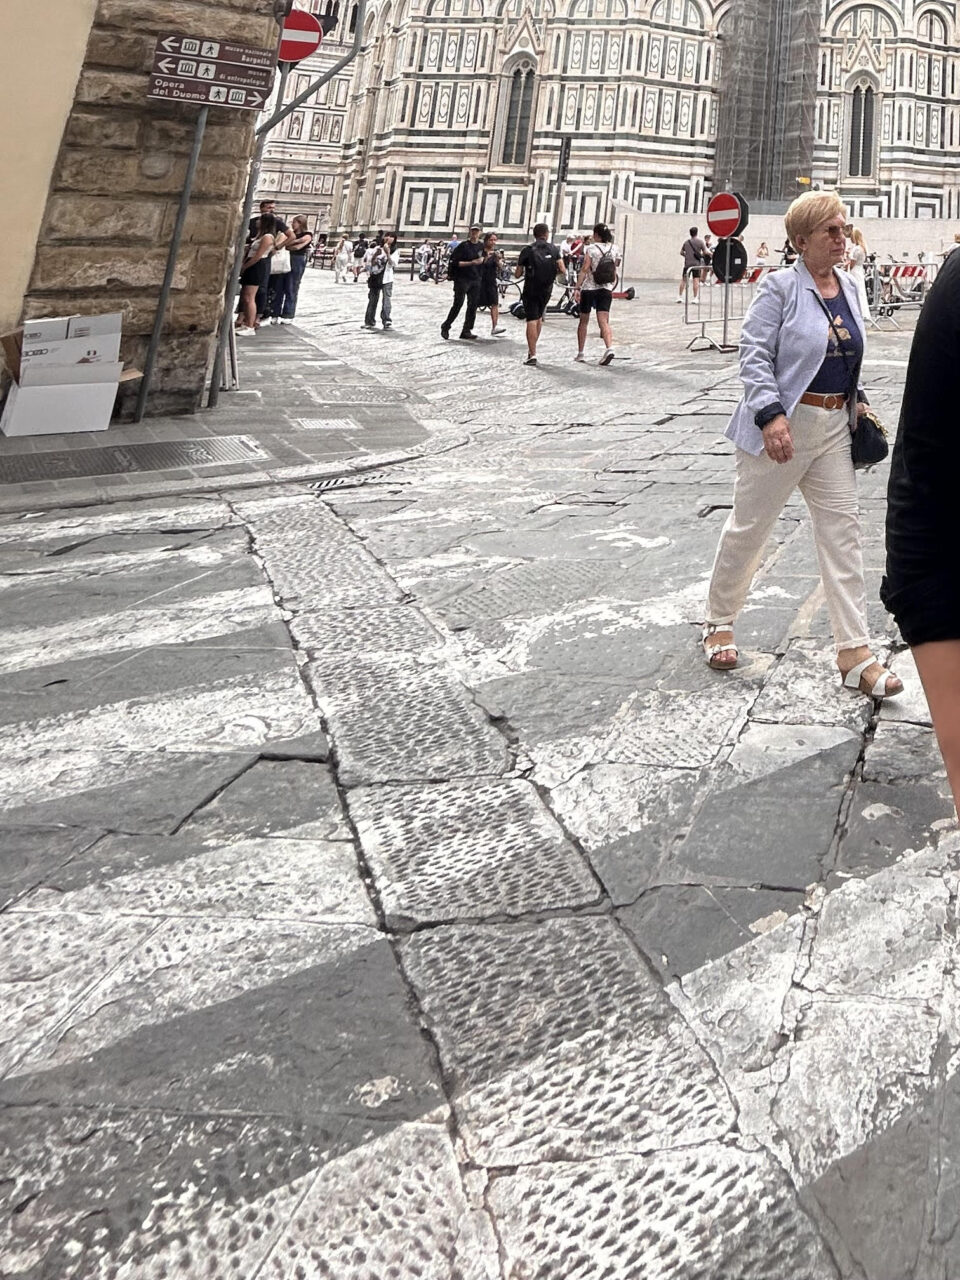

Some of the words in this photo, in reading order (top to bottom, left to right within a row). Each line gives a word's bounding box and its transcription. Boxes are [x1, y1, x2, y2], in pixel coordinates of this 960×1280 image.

[245, 48, 272, 57] nazionale
[241, 55, 271, 65] Bargello
[154, 79, 185, 89] Opera
[152, 88, 169, 96] del
[172, 89, 206, 100] Duomo
